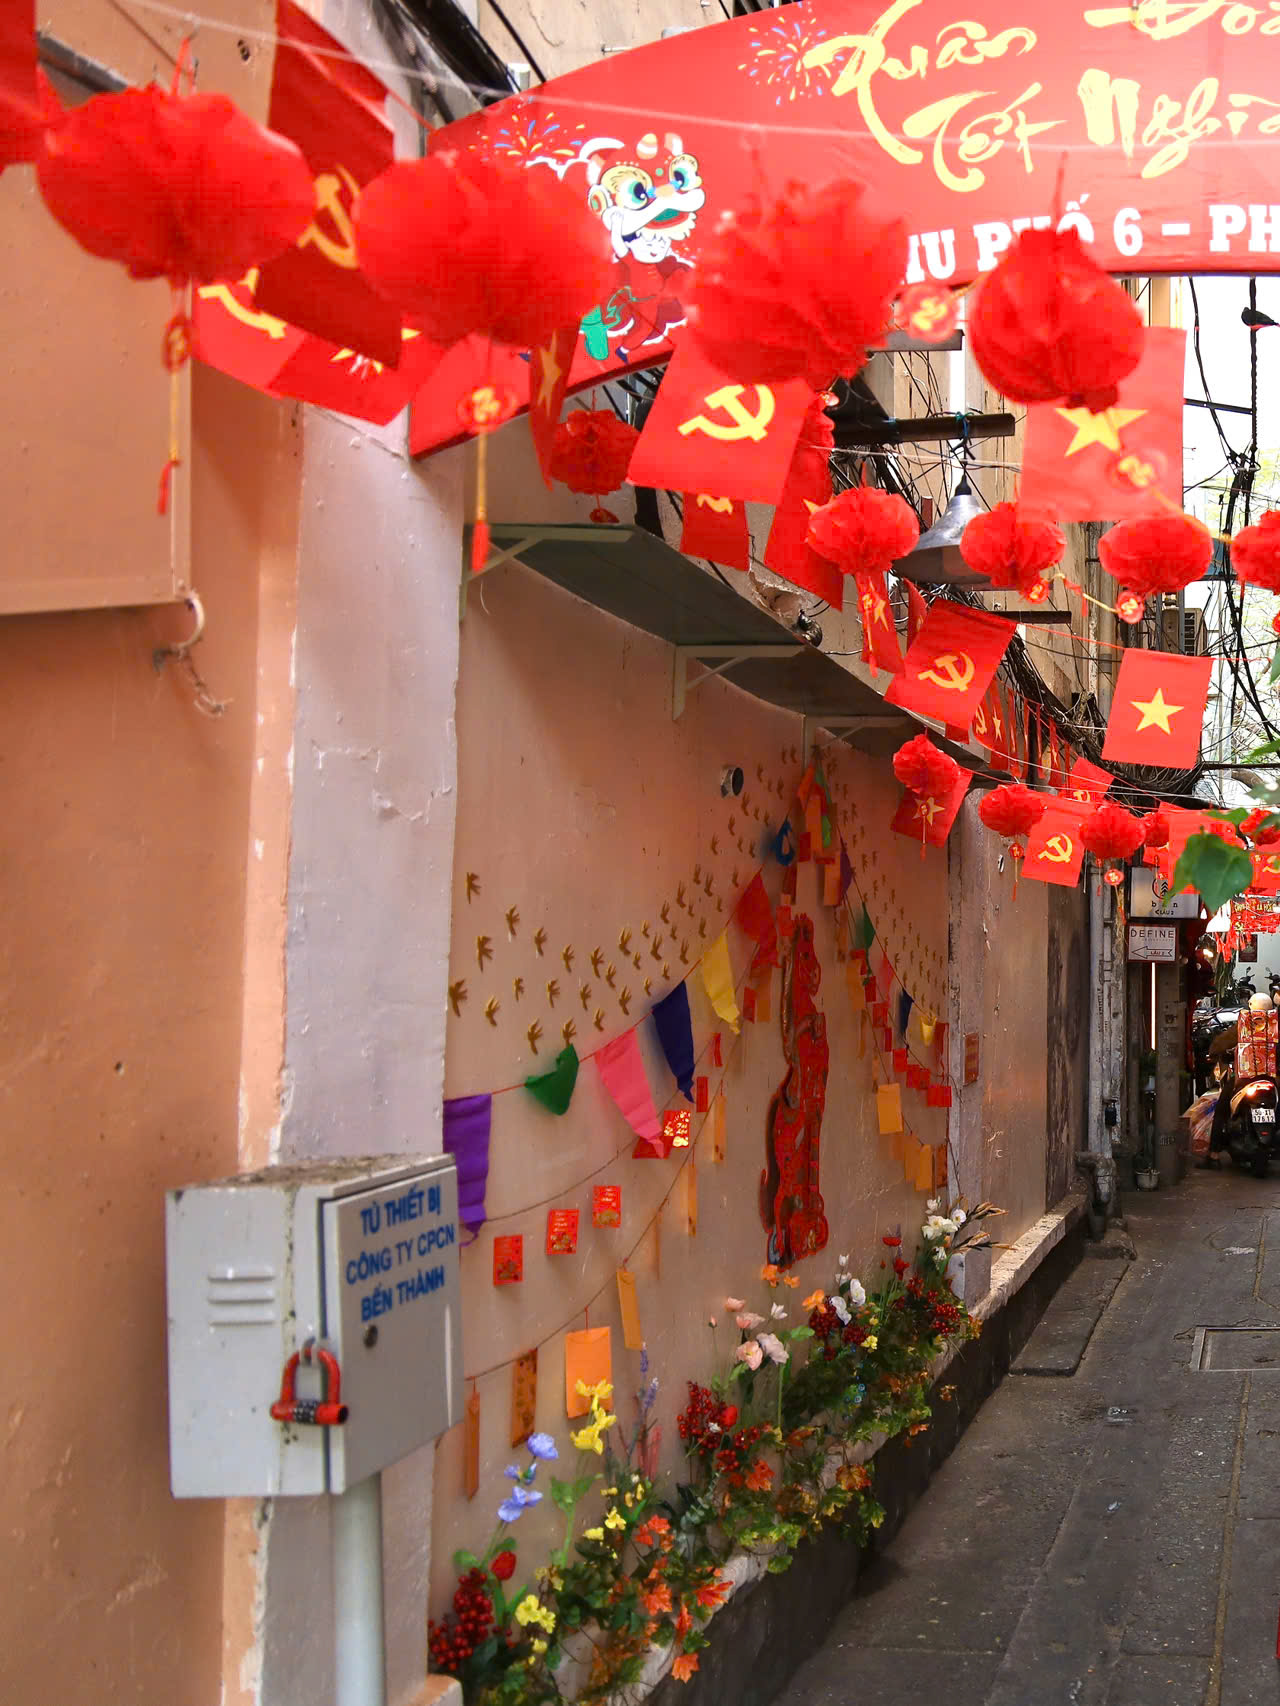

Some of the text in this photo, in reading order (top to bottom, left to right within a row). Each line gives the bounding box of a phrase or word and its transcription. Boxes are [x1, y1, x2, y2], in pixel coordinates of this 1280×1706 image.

[902, 81, 1068, 192] Tết
[1113, 207, 1144, 256] 6
[1131, 929, 1174, 939] DEFINE
[360, 1183, 441, 1236] TỦ THIẾT BỊ
[346, 1224, 455, 1285] CÔNG TY CPCN
[361, 1265, 444, 1323] BẾN THÀNH
